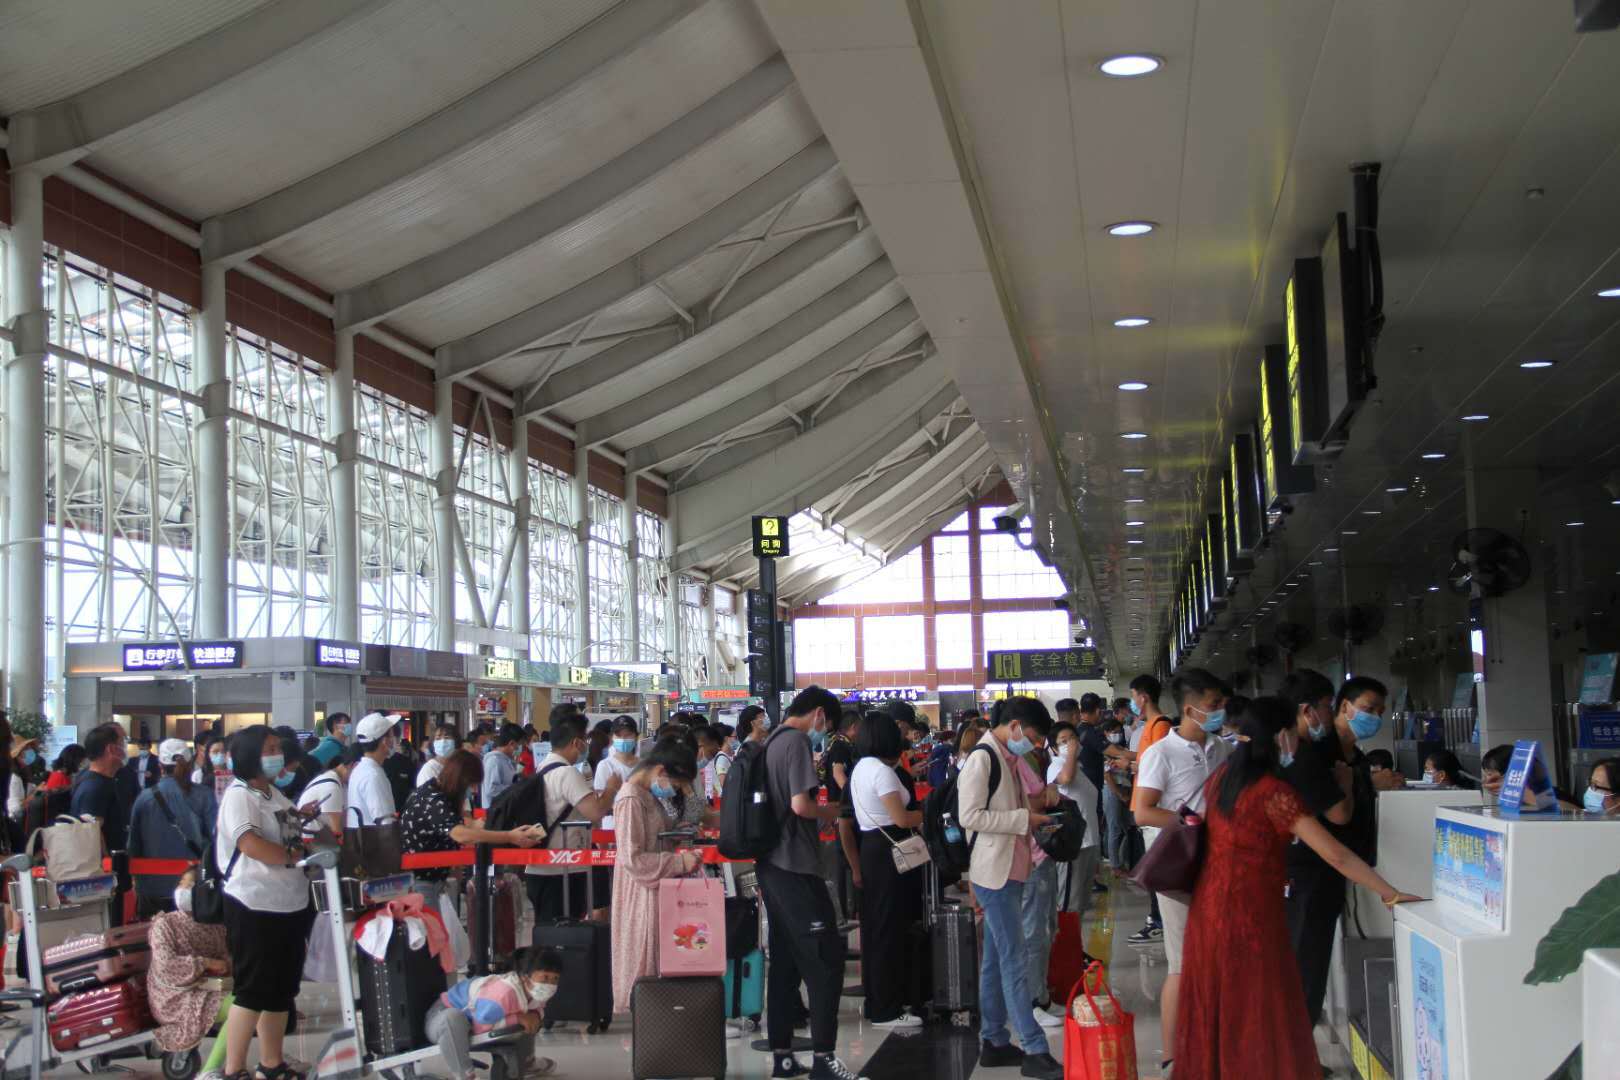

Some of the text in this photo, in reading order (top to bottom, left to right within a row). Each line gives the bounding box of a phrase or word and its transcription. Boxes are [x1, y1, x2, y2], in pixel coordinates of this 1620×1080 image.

[761, 539, 780, 549] 问询
[1031, 652, 1096, 668] 安全检查
